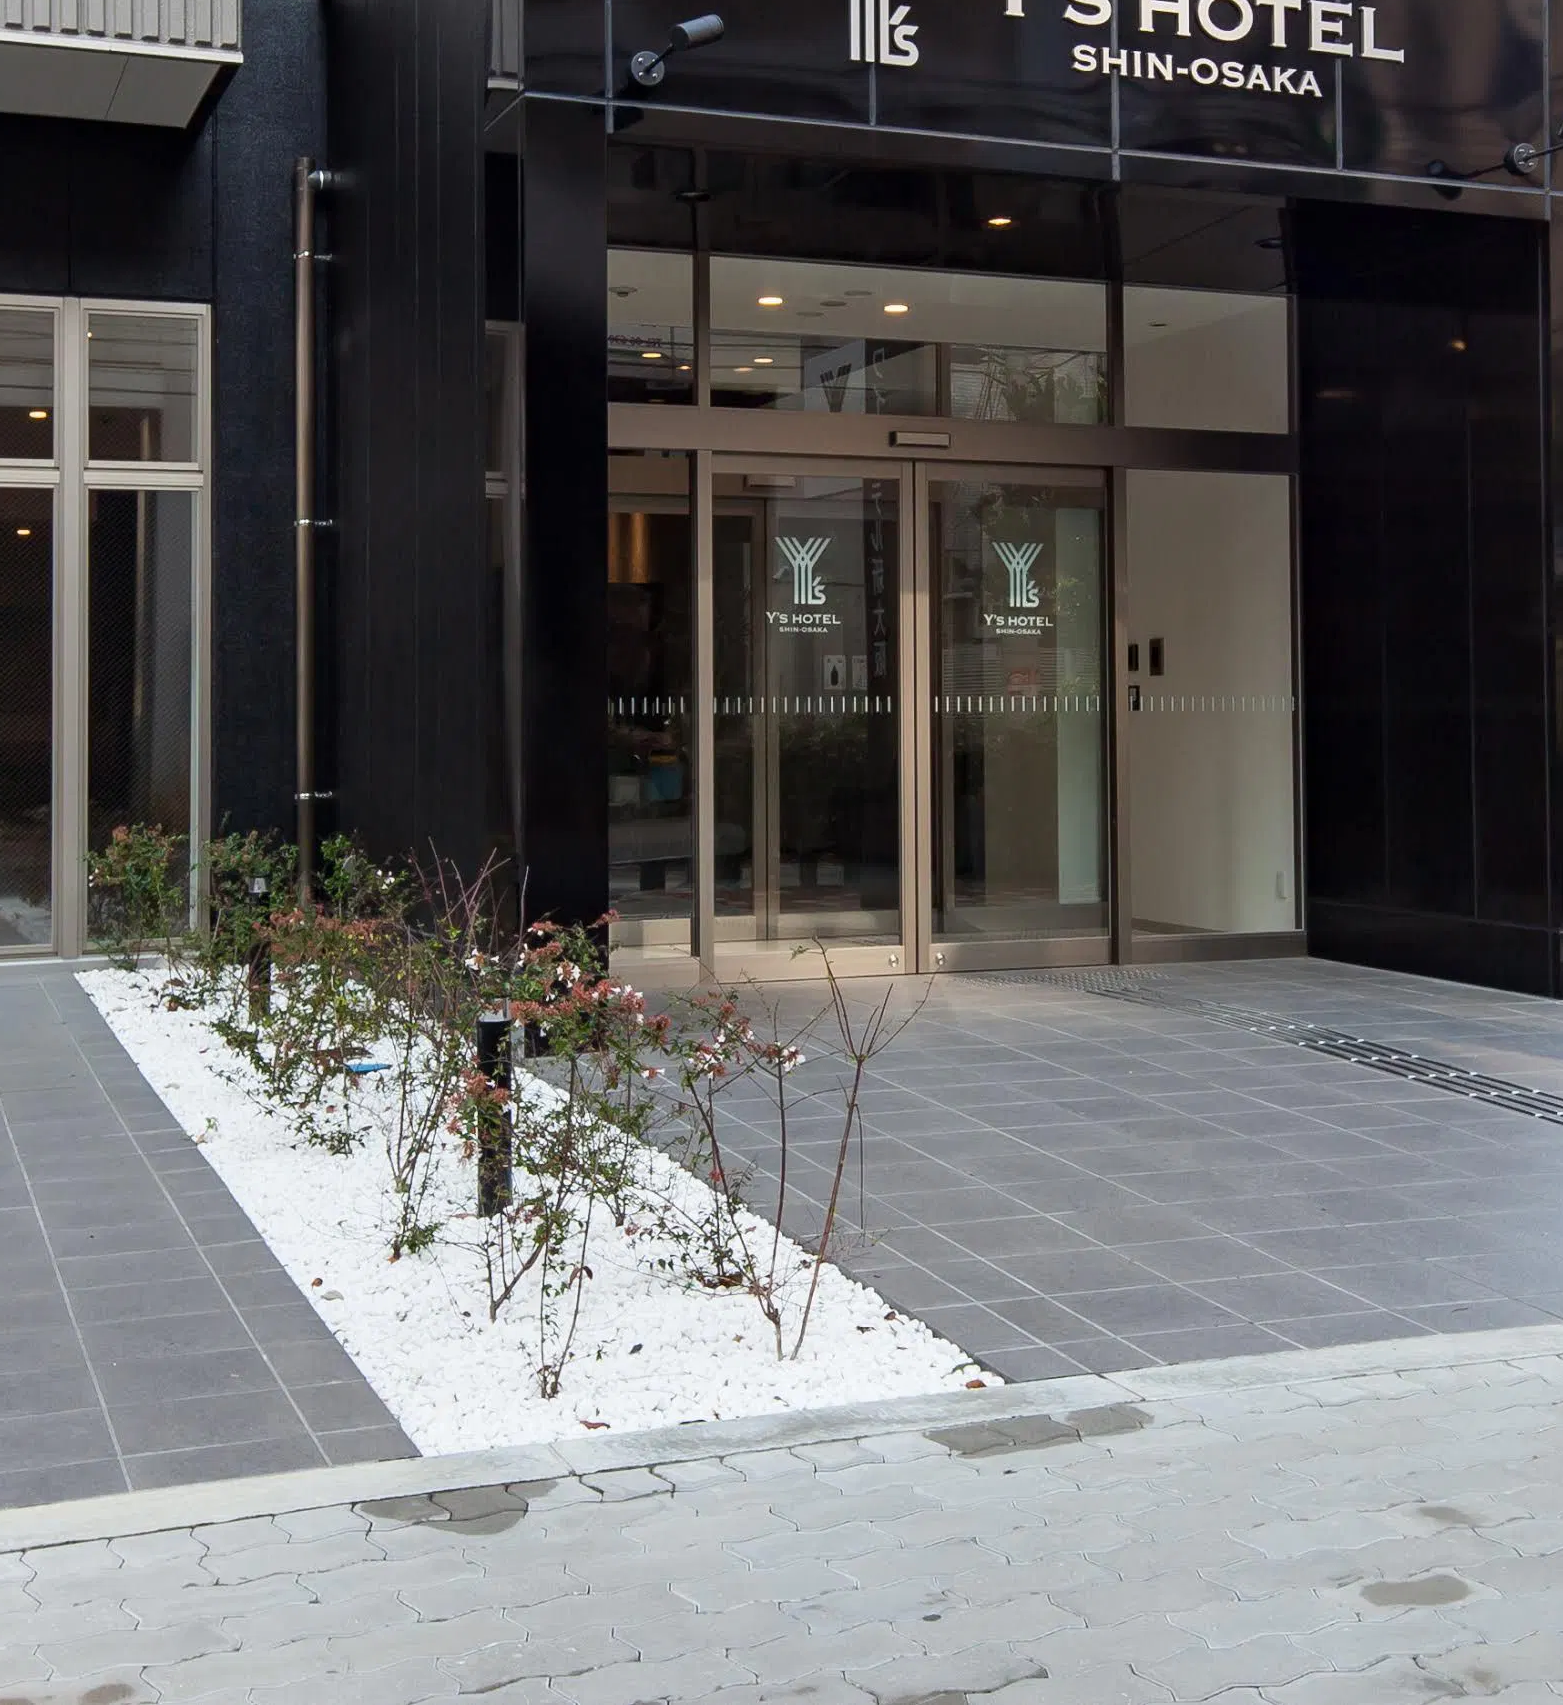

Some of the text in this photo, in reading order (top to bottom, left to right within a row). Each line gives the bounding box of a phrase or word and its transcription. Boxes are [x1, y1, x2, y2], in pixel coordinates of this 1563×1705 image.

[1072, 44, 1323, 98] SHIN-OSAKA
[766, 611, 841, 625] Y'S HOTEL
[983, 614, 1053, 627] Y'S HOTEL
